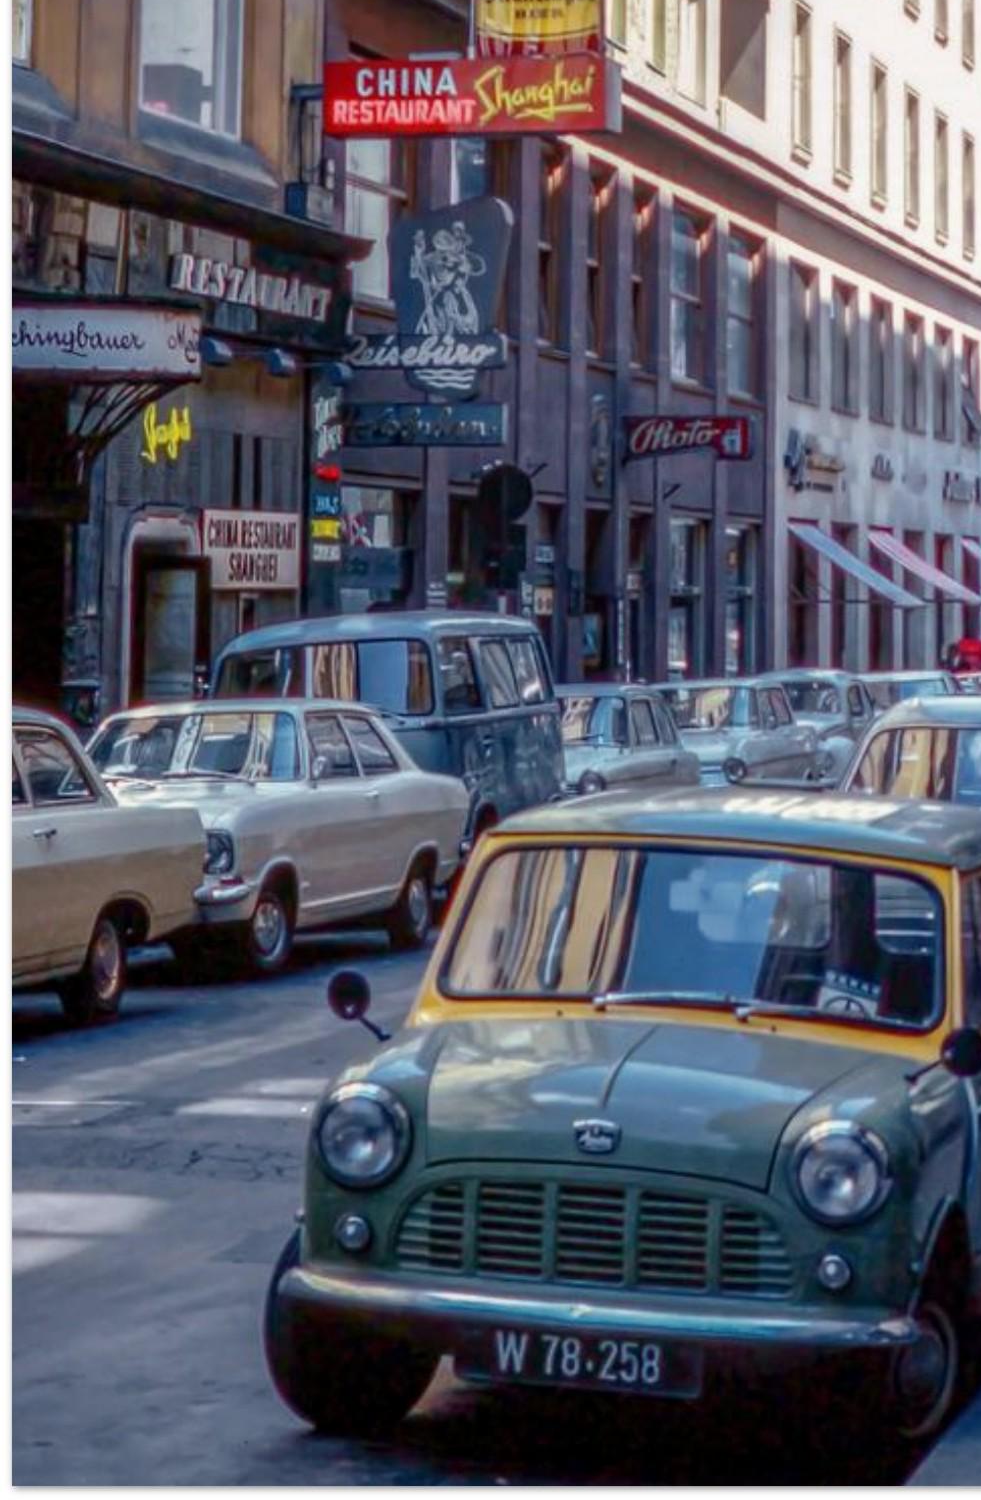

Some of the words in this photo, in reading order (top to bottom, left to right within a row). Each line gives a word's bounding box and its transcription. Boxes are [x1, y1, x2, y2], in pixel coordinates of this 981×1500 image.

[356, 67, 458, 97] CHINA
[473, 62, 596, 127] Shanghai
[332, 99, 475, 125] RESTAURANT
[172, 253, 332, 321] RESTAURANT
[343, 334, 497, 367] Reisebüro
[208, 518, 239, 547] CHINA
[241, 520, 297, 550] RESTAURANT
[495, 1330, 528, 1375] W
